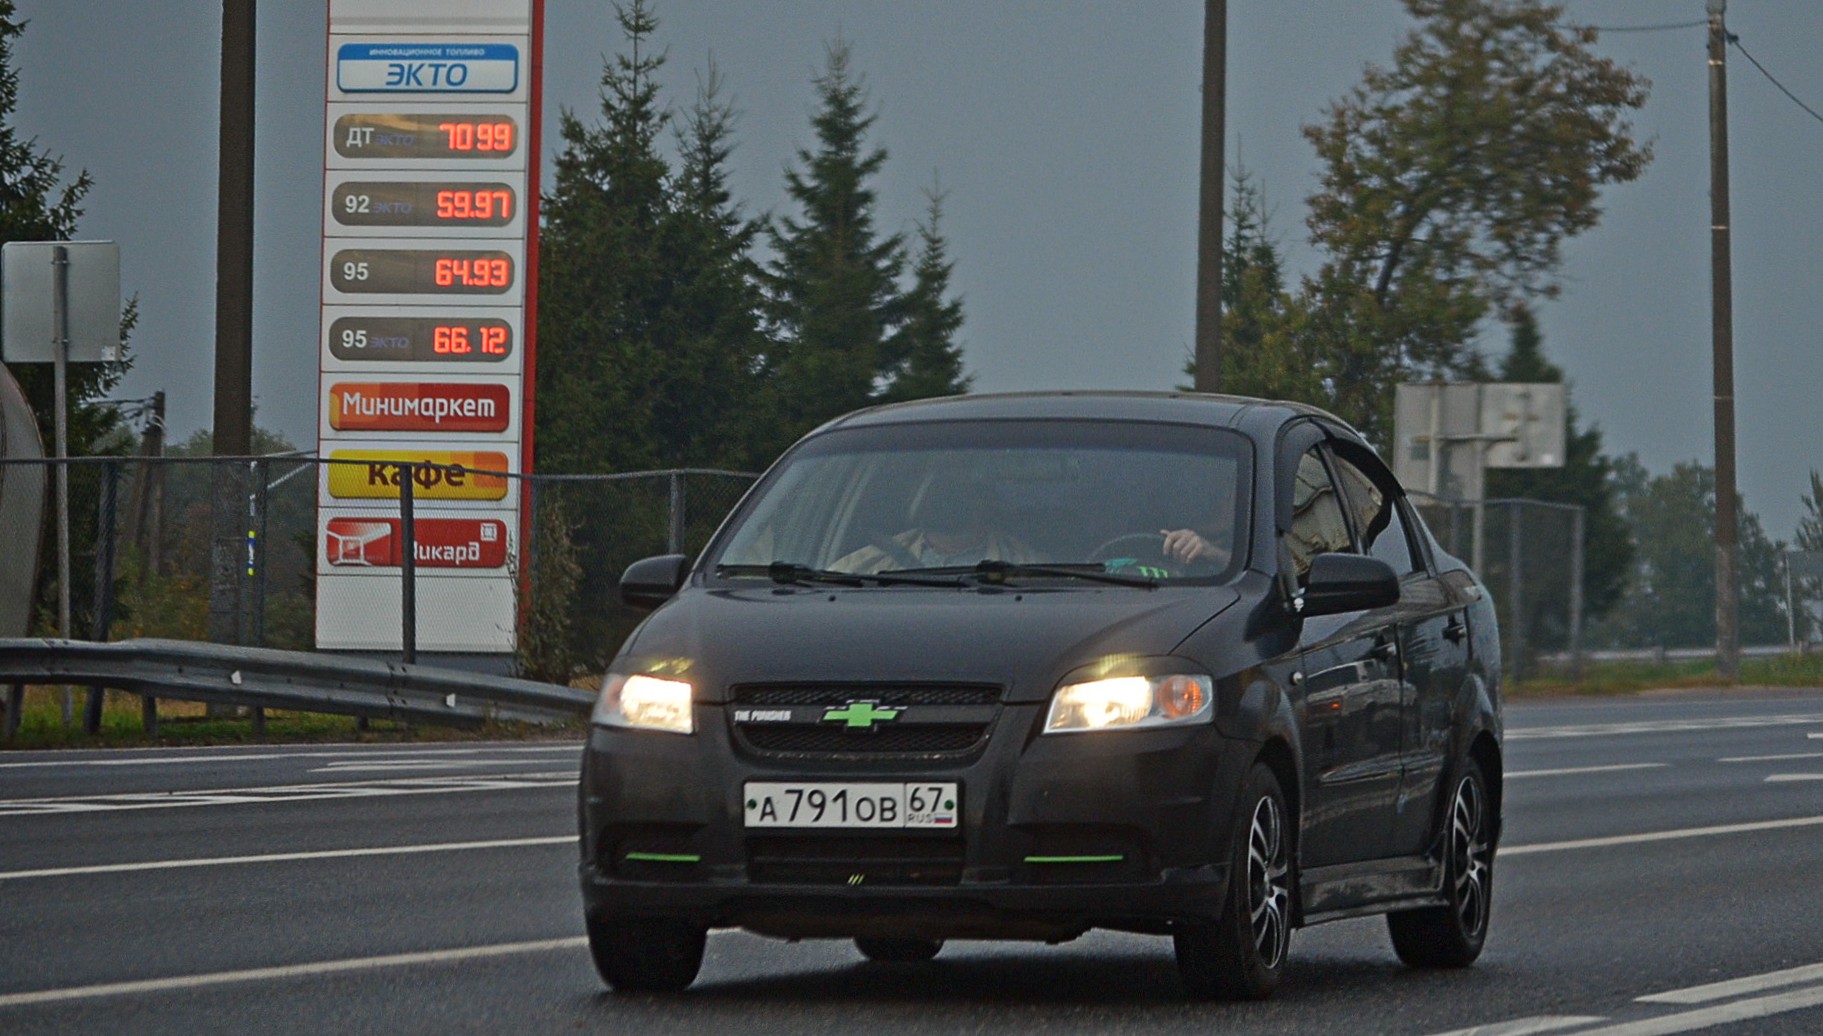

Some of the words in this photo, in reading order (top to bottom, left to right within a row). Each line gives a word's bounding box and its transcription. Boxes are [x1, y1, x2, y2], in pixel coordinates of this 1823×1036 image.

[369, 48, 442, 57] ИННОВАЦИОННОЕ
[446, 48, 485, 56] ТОПЛИВО
[385, 63, 468, 86] ЭКТО
[346, 127, 374, 147] ДТ
[345, 195, 370, 213] 92
[437, 190, 511, 219] 59.97
[343, 262, 369, 280] 95
[435, 258, 509, 287] 64.93
[341, 330, 367, 348] 95
[342, 391, 496, 424] Минимаркет
[412, 541, 480, 566] икард
[910, 786, 943, 813] 67
[908, 813, 933, 824] RUS
